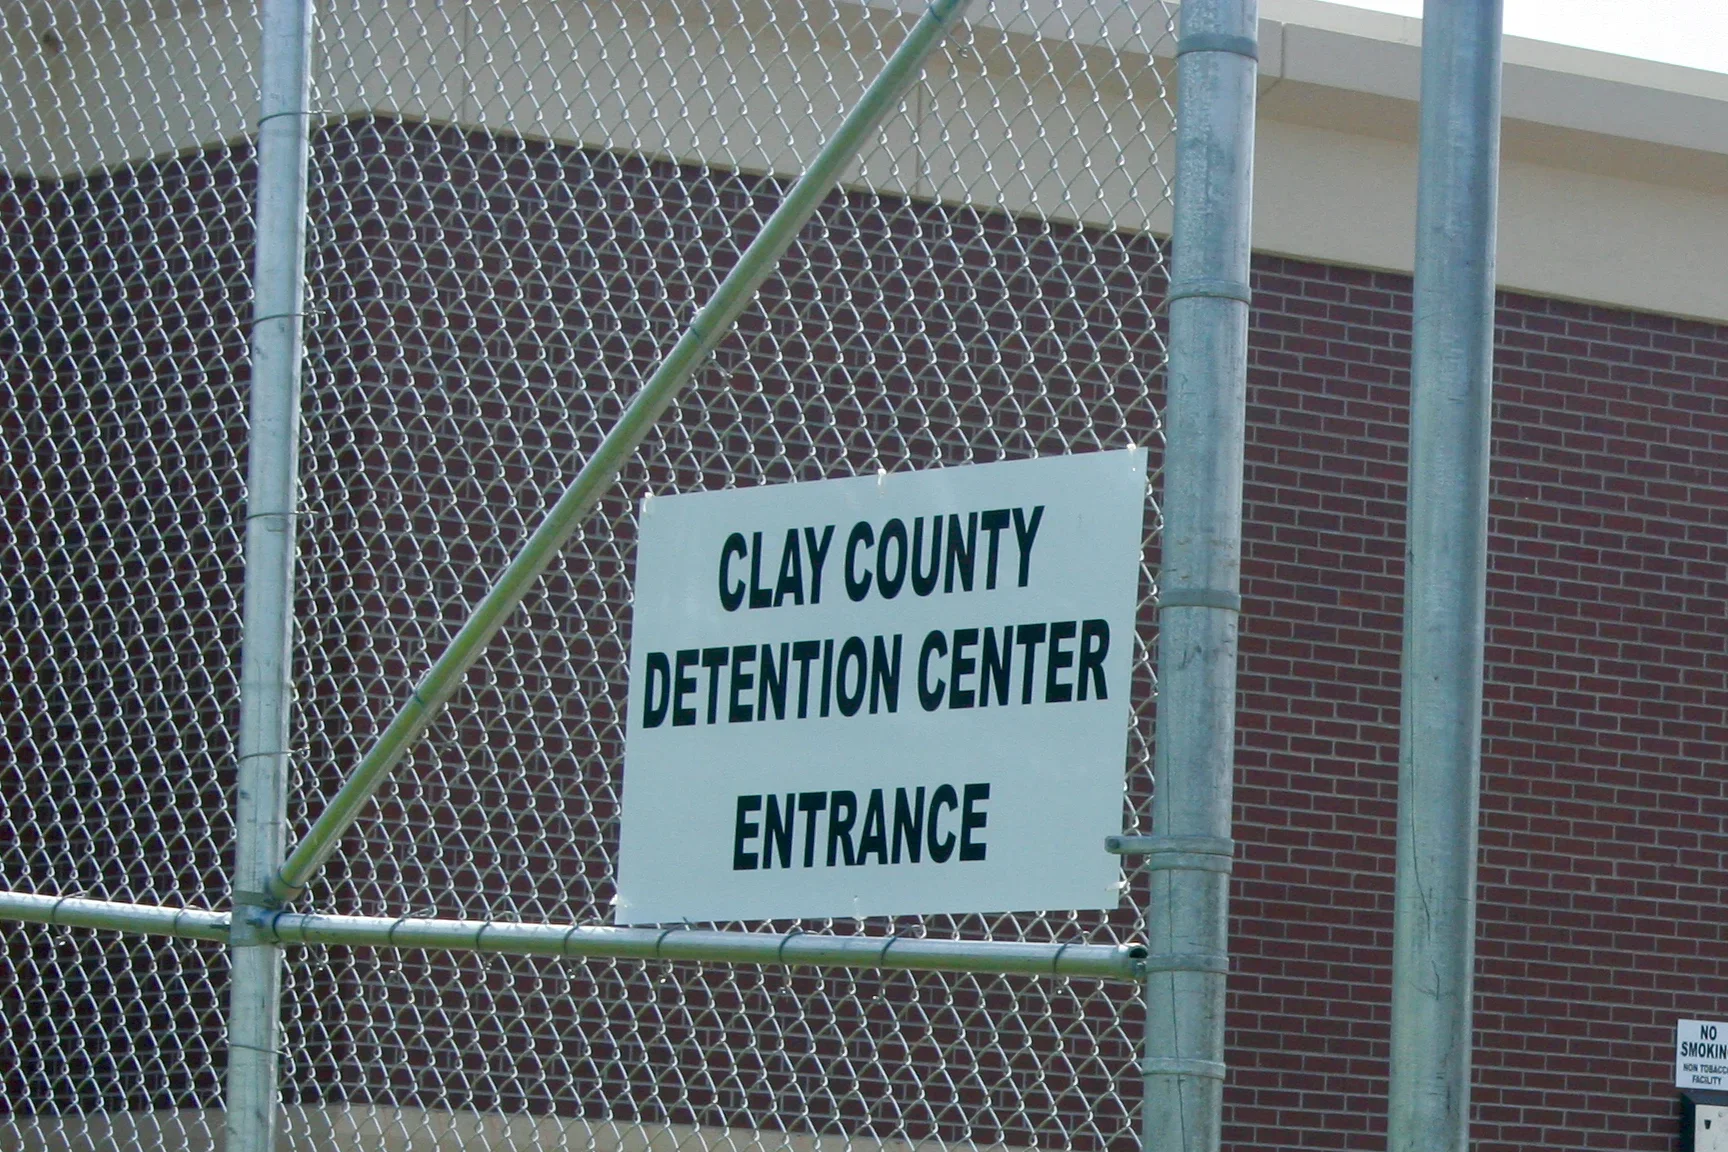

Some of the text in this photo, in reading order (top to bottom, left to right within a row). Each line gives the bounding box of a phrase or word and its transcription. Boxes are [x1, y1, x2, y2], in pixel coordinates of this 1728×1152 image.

[718, 505, 1045, 612] CLAY COUNTY
[642, 618, 1110, 729] DETENTION CENTER
[732, 782, 991, 871] ENTRANCE
[1700, 1025, 1717, 1040] NO
[1683, 1063, 1699, 1071] NON
[1692, 1075, 1722, 1085] FACILITY
